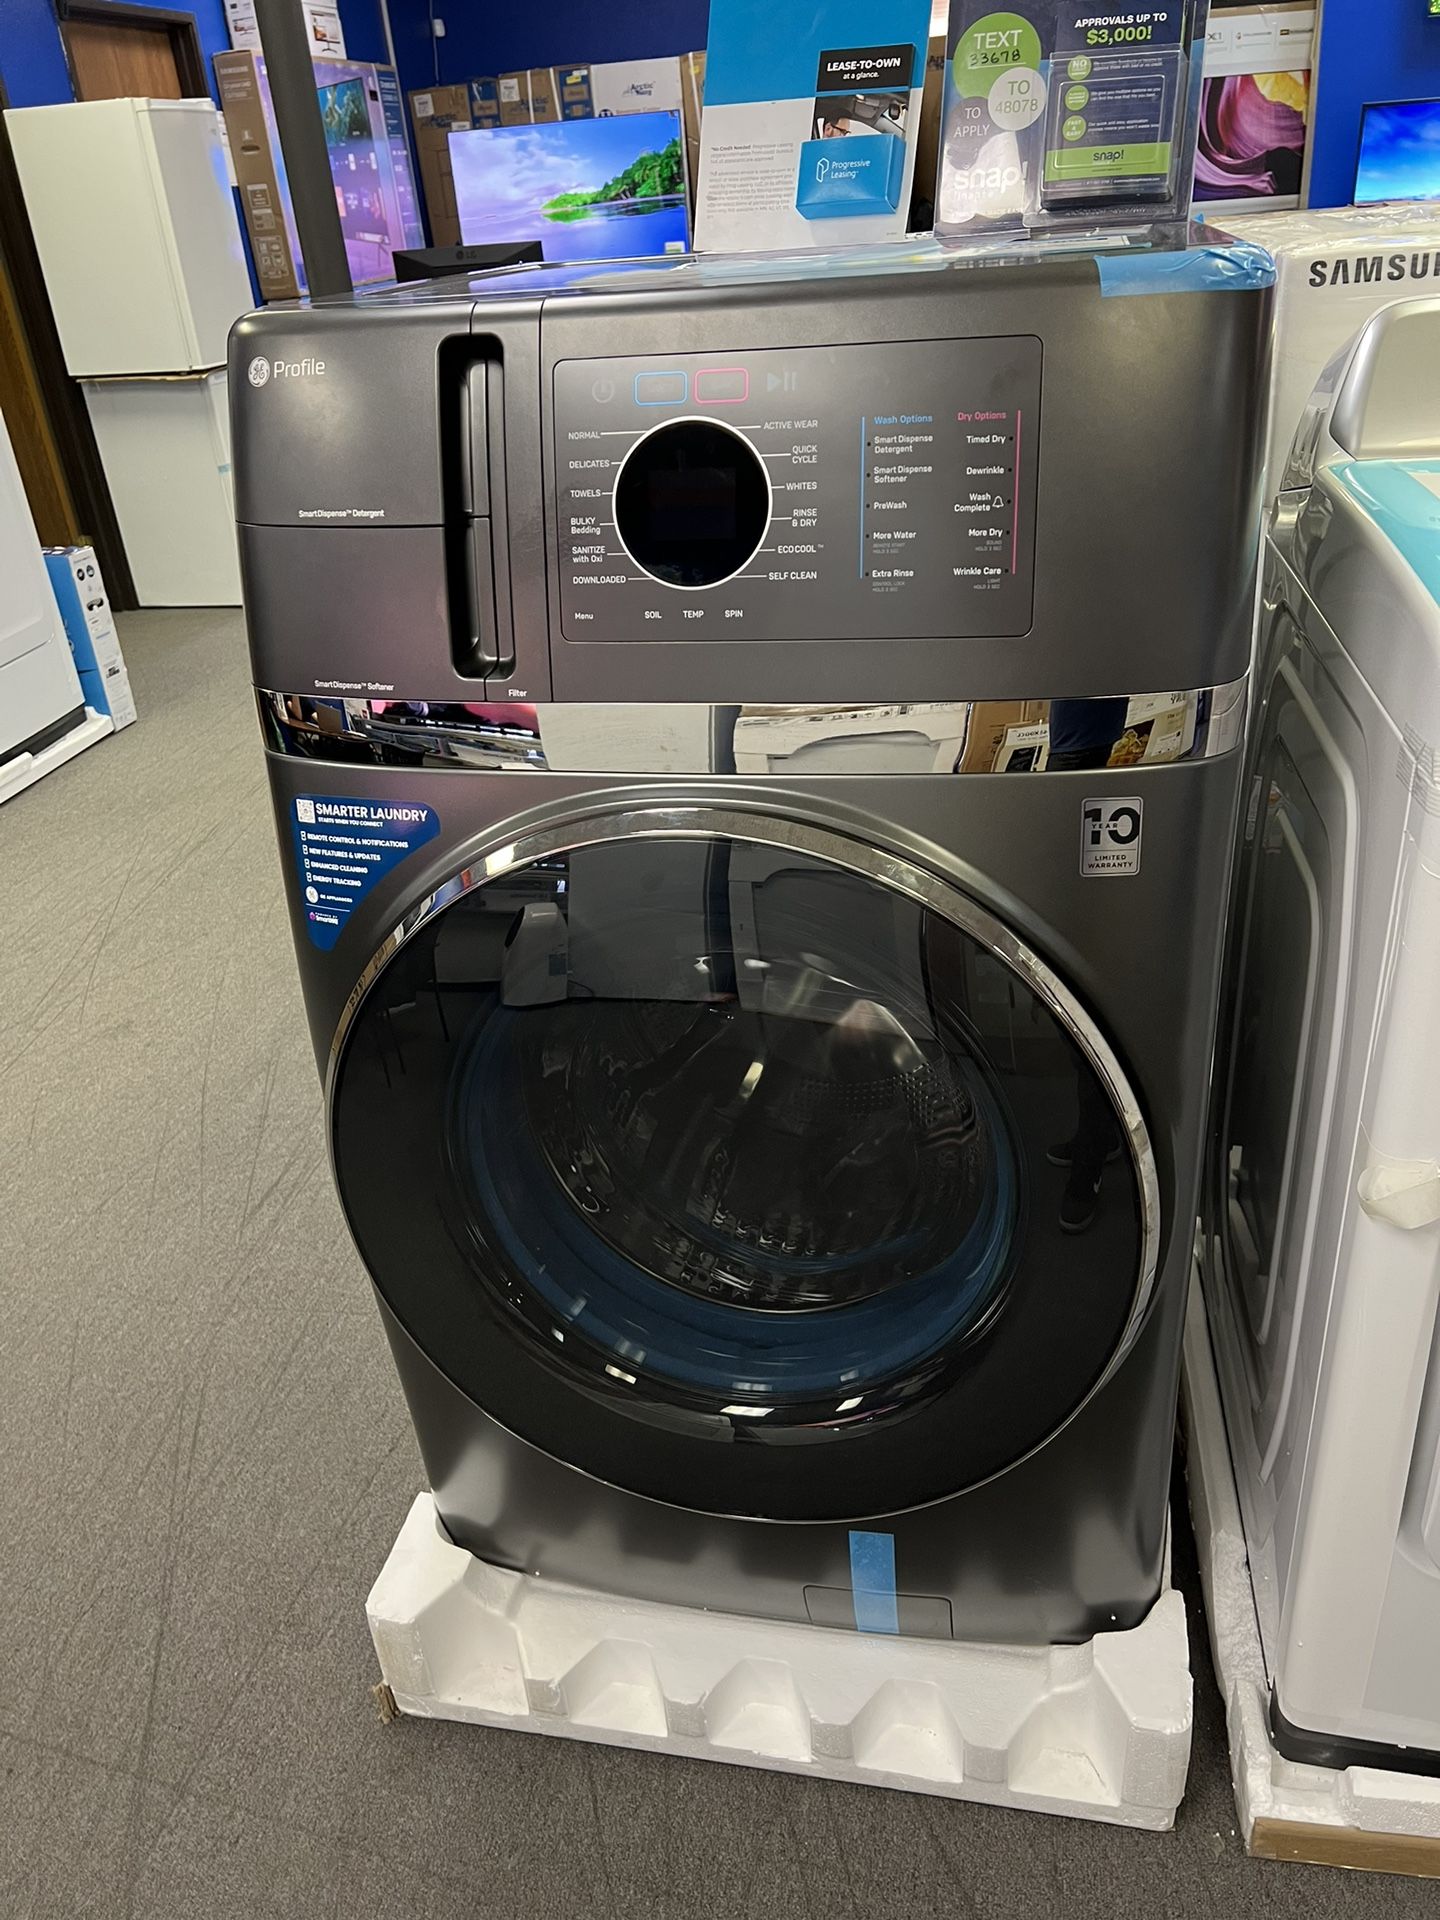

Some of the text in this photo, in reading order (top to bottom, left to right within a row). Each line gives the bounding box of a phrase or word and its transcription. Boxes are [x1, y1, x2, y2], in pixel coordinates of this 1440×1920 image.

[1074, 12, 1167, 28] APPROVALS UP TO
[973, 29, 1023, 49] TEXT
[1086, 25, 1152, 45] $3,000!
[969, 49, 1021, 66] 33678
[827, 58, 901, 72] LEASE-TO-OWN
[842, 72, 850, 80] at
[856, 71, 880, 80] glance.
[1008, 80, 1030, 96] TO
[995, 98, 1038, 114] 48078
[964, 107, 980, 119] TO
[953, 124, 990, 138] APPLY
[1093, 150, 1124, 162] snap!
[832, 160, 871, 170] Progressive
[953, 161, 1028, 194] snap!
[274, 358, 326, 378] Profile
[874, 415, 933, 424] Wash Options
[958, 411, 1006, 422] Dry Options
[763, 419, 818, 430] ACTIVE WEAR
[568, 431, 600, 440] NORMAL
[966, 435, 1006, 444] Timed Dry
[792, 445, 818, 454] QUICK
[874, 445, 912, 454] Detergent
[792, 454, 818, 464] CYCLE
[569, 460, 610, 469] DELICATES
[966, 466, 1004, 475] Dewrinkle
[874, 475, 908, 484] Softener
[786, 482, 818, 490] WHITES
[570, 488, 601, 498] TOWELS
[874, 502, 908, 510] PreWash
[954, 504, 990, 513] Complete
[352, 509, 384, 518] Detergent
[793, 508, 818, 517] RINSE
[570, 518, 596, 526] BULKY
[792, 518, 818, 527] & DRY
[571, 526, 601, 536] Bedding
[893, 531, 916, 539] Water
[990, 528, 1003, 537] Dry
[572, 546, 606, 554] SANITIZE
[572, 554, 603, 564] with Oxi
[768, 571, 818, 580] SELF CLEAN
[872, 569, 914, 578] Extra Rinse
[953, 567, 1002, 576] Wrinkle Care
[573, 575, 626, 584] DOWNLOADED
[574, 612, 594, 620] Menu
[644, 609, 744, 619] SOIL TEMP SPIN
[367, 682, 394, 691] Softener
[508, 688, 528, 698] Filter
[315, 803, 428, 822] SMARTER LAUNDRY
[1084, 806, 1140, 844] 10
[307, 833, 328, 841] REMOTE
[328, 835, 356, 844] CONTROL
[362, 838, 408, 848] NOTIFICATIONS
[322, 850, 348, 858] FEATURES
[354, 852, 381, 861] UPDATES
[310, 861, 368, 874] ENHANCED CLEANING
[312, 874, 362, 887] ENERGY TRACKING
